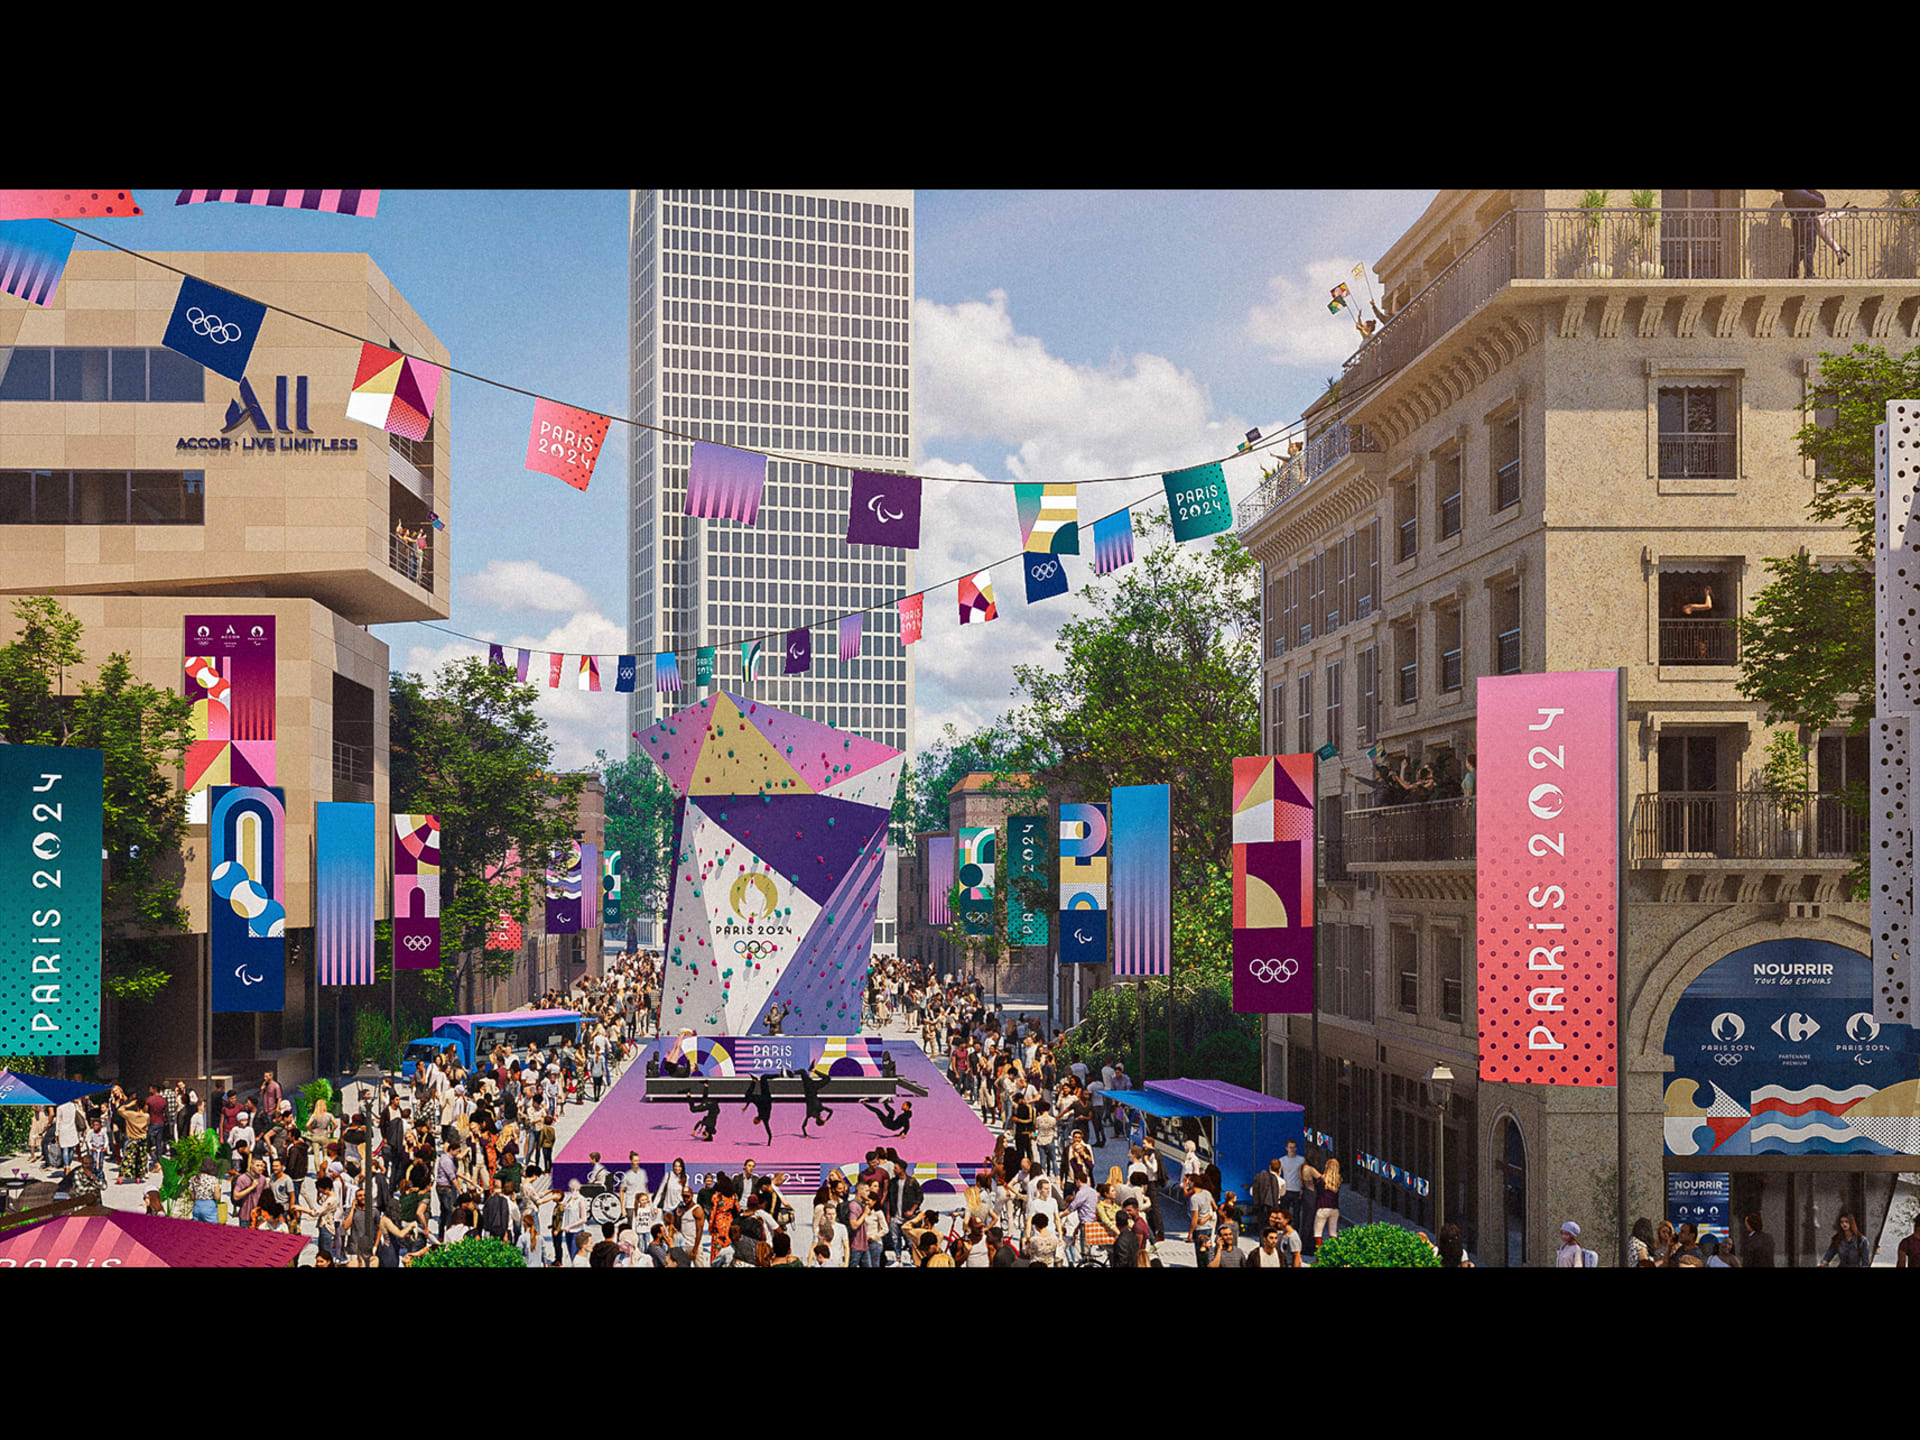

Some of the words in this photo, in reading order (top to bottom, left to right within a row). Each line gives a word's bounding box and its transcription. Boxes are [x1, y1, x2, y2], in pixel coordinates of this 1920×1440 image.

[176, 437, 232, 451] ACCOR
[242, 437, 275, 451] LIVE
[280, 438, 358, 451] LIMITLESS
[538, 438, 590, 470] 2024
[1179, 500, 1221, 520] 2024
[1528, 708, 1565, 857] 2024
[32, 773, 62, 889] 2024
[715, 926, 753, 935] PARIS
[757, 926, 792, 935] 2024
[1753, 963, 1834, 975] NOURRIR
[753, 1058, 792, 1070] 2024
[1674, 1180, 1723, 1190] NOURRIR
